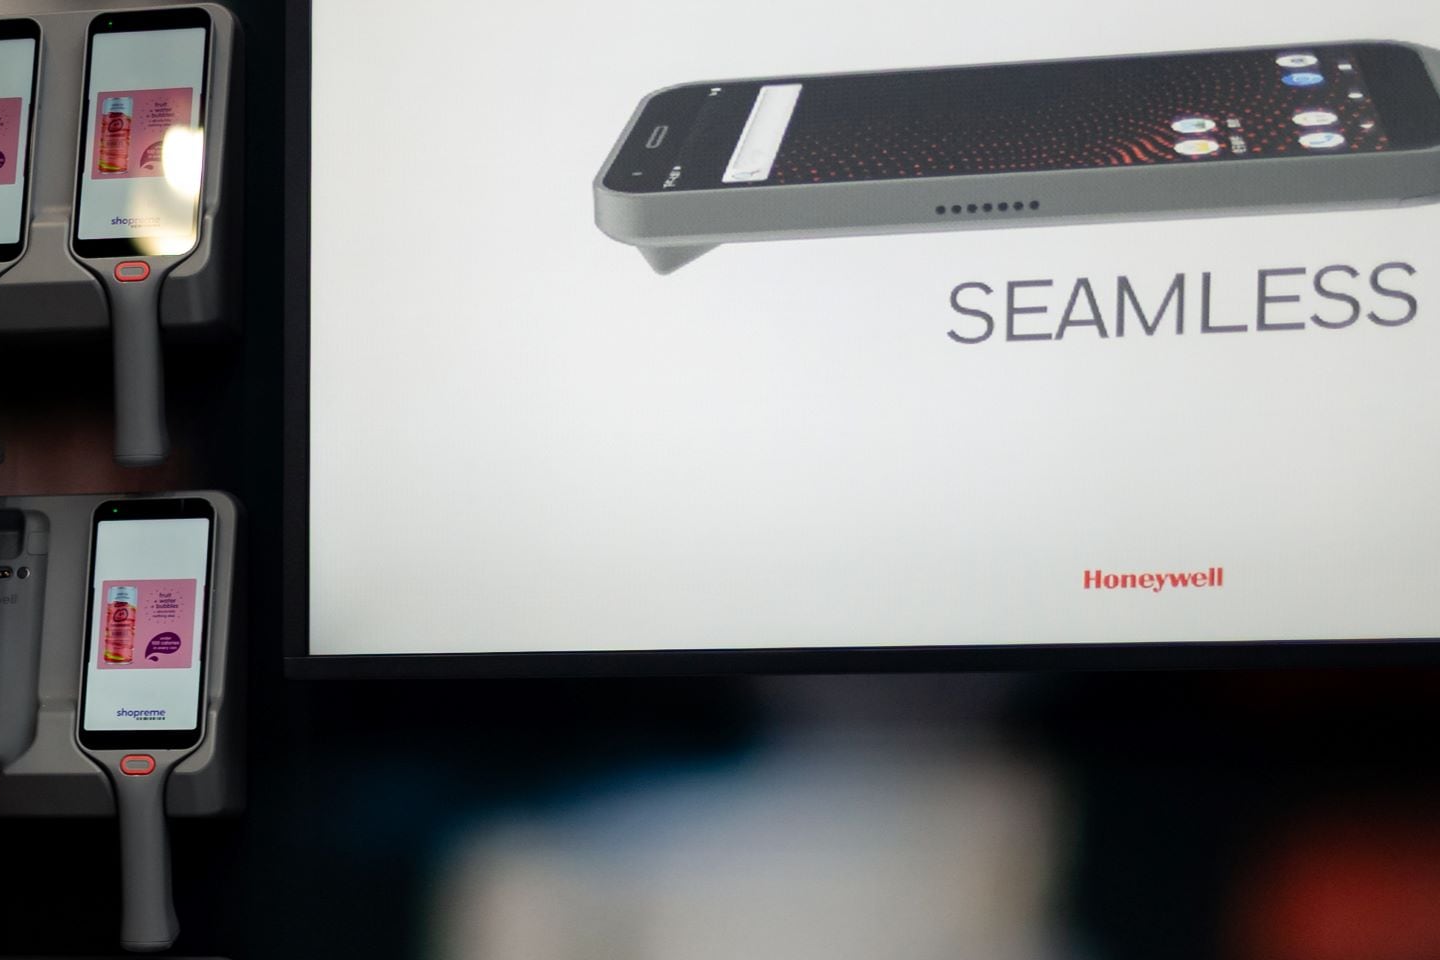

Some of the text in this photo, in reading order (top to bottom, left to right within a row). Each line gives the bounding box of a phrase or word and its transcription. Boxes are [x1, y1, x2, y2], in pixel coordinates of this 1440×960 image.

[947, 261, 1419, 344] SEAMLESS
[1083, 567, 1224, 593] Honeywell
[116, 708, 166, 718] shopreme
